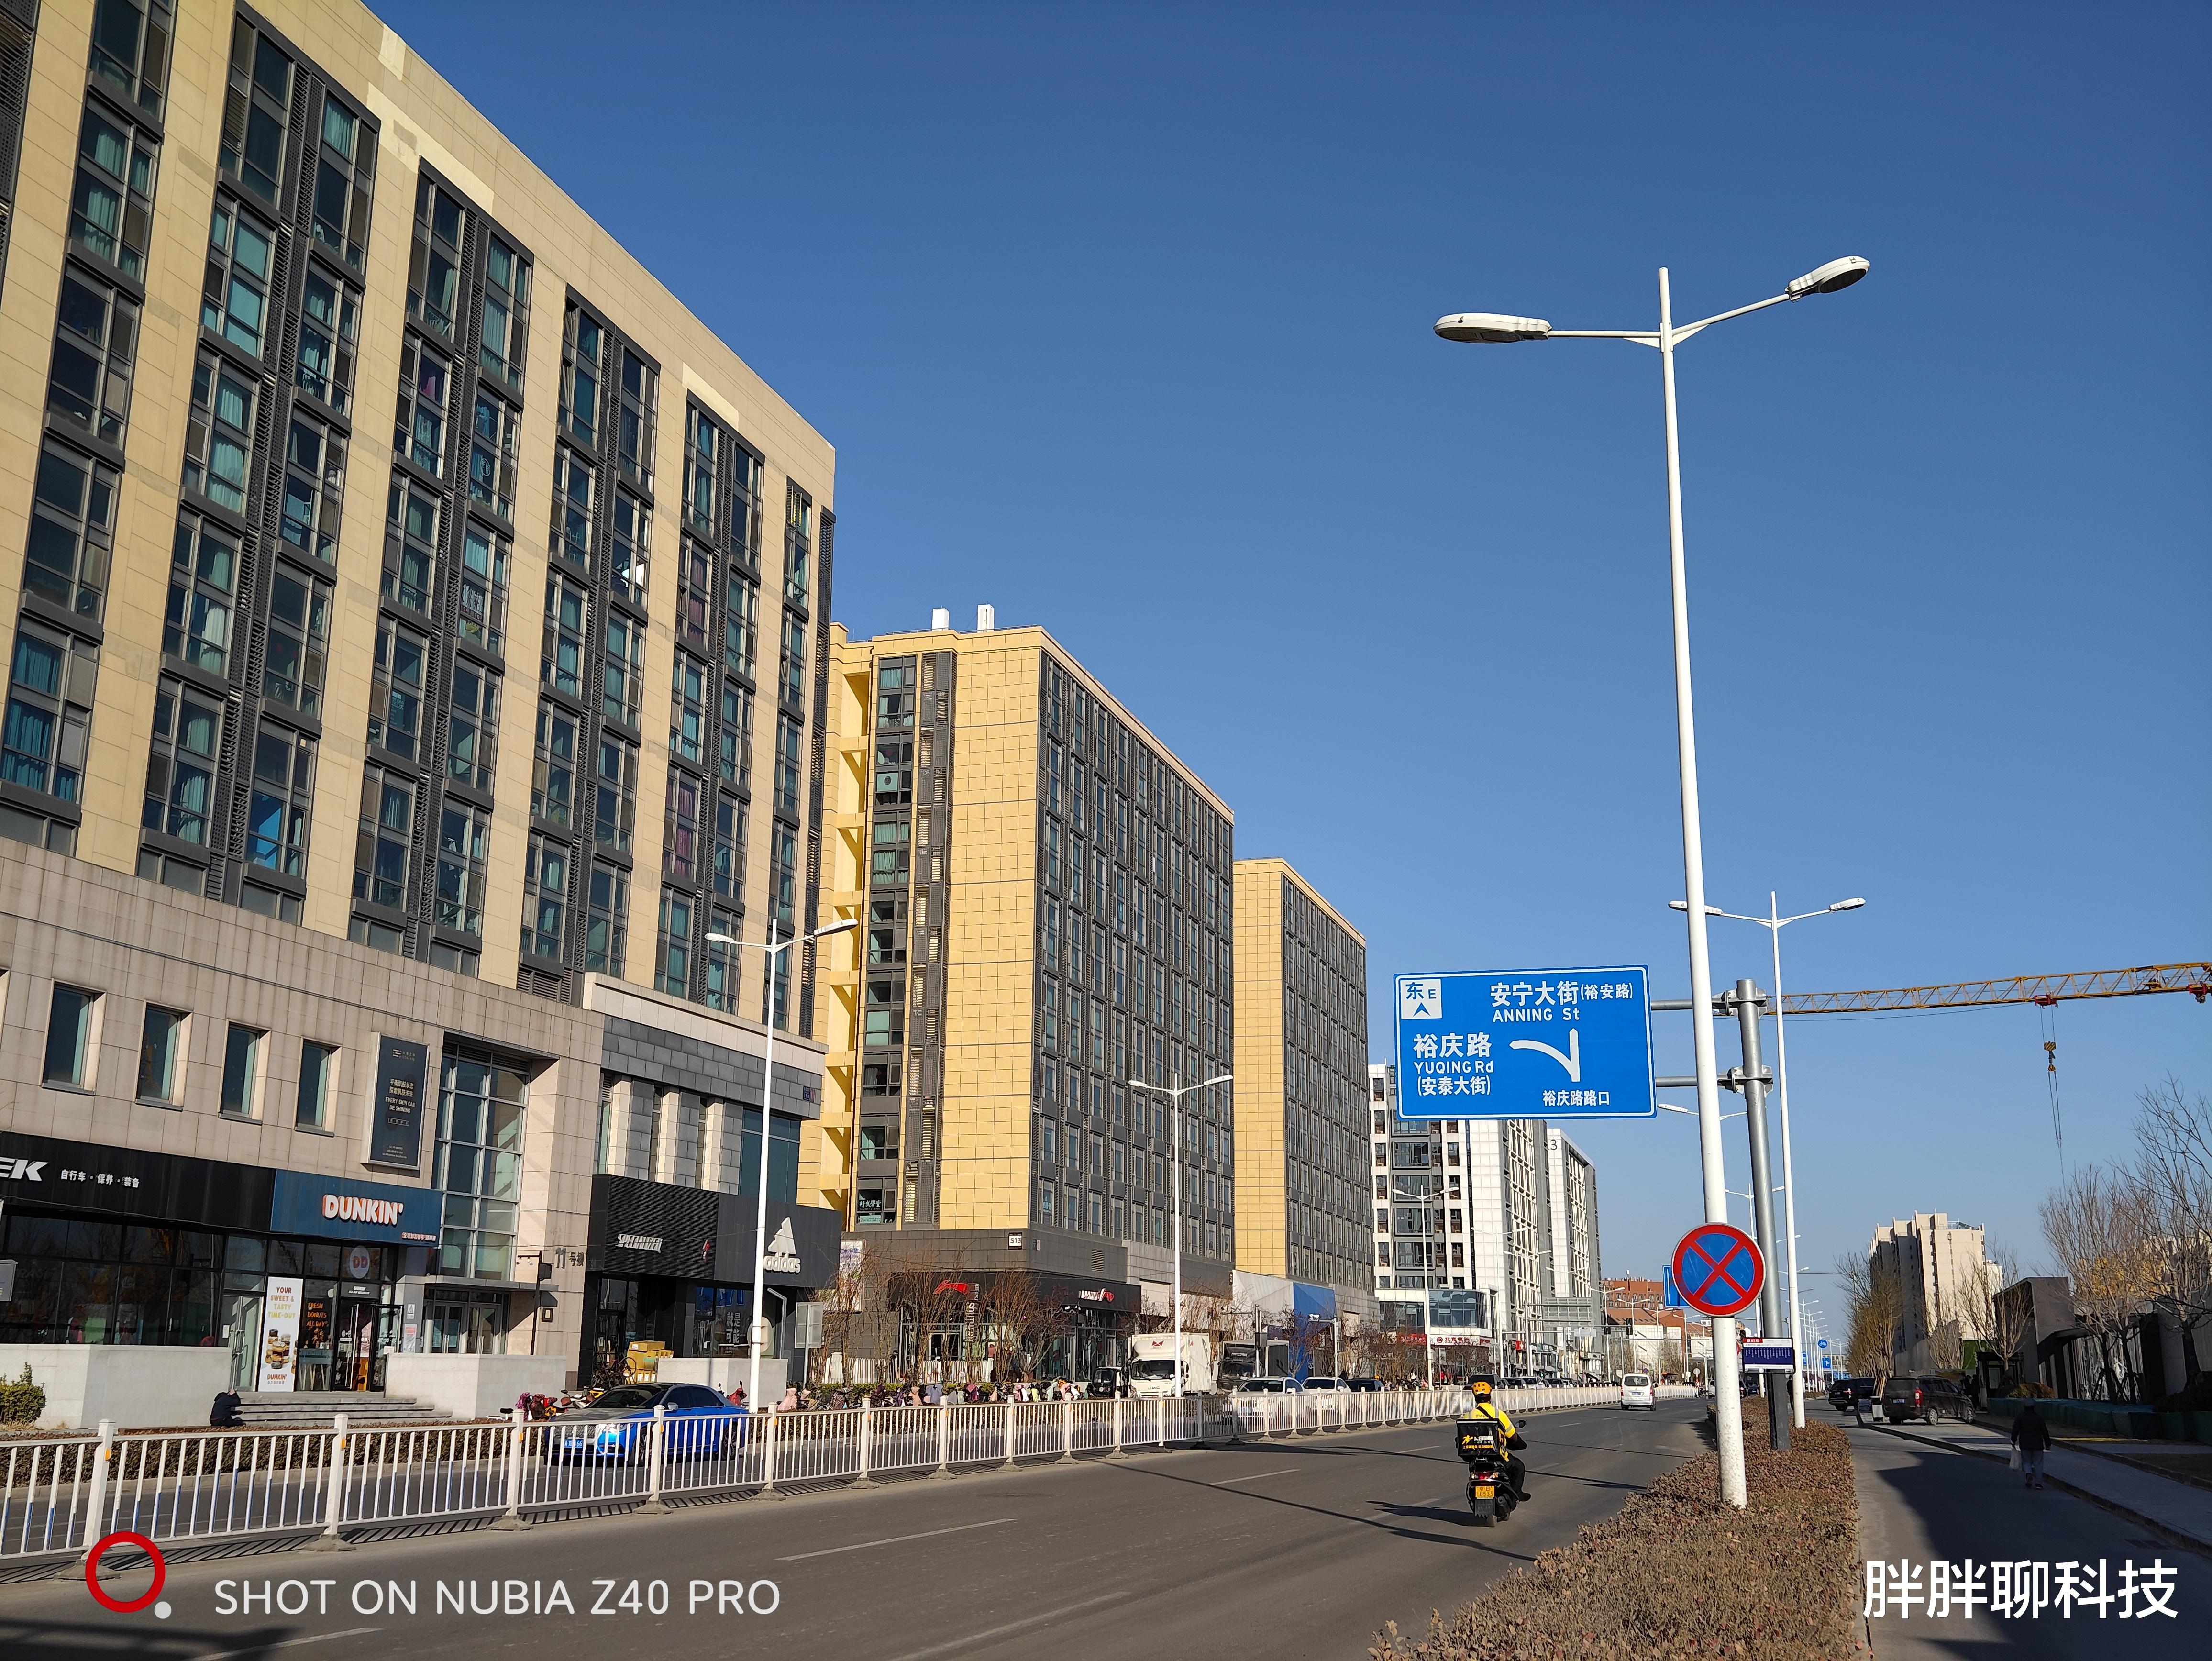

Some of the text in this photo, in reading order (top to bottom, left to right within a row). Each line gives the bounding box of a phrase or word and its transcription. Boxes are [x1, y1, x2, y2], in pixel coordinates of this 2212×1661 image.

[1405, 982, 1437, 1000] 东 E
[1490, 980, 1633, 1007] 安宁大街 (裕安路)
[1492, 1007, 1580, 1022] ANNING St
[1413, 1031, 1492, 1059] 裕庆路
[1413, 1060, 1493, 1074] YUQING Rd
[1417, 1074, 1491, 1096] (安泰大街)
[1542, 1089, 1610, 1107] 裕庆路路口
[322, 1194, 404, 1226] DUNKIN'
[763, 1251, 801, 1273] adidas
[726, 1312, 741, 1327] 就是
[726, 1328, 740, 1343] 可能
